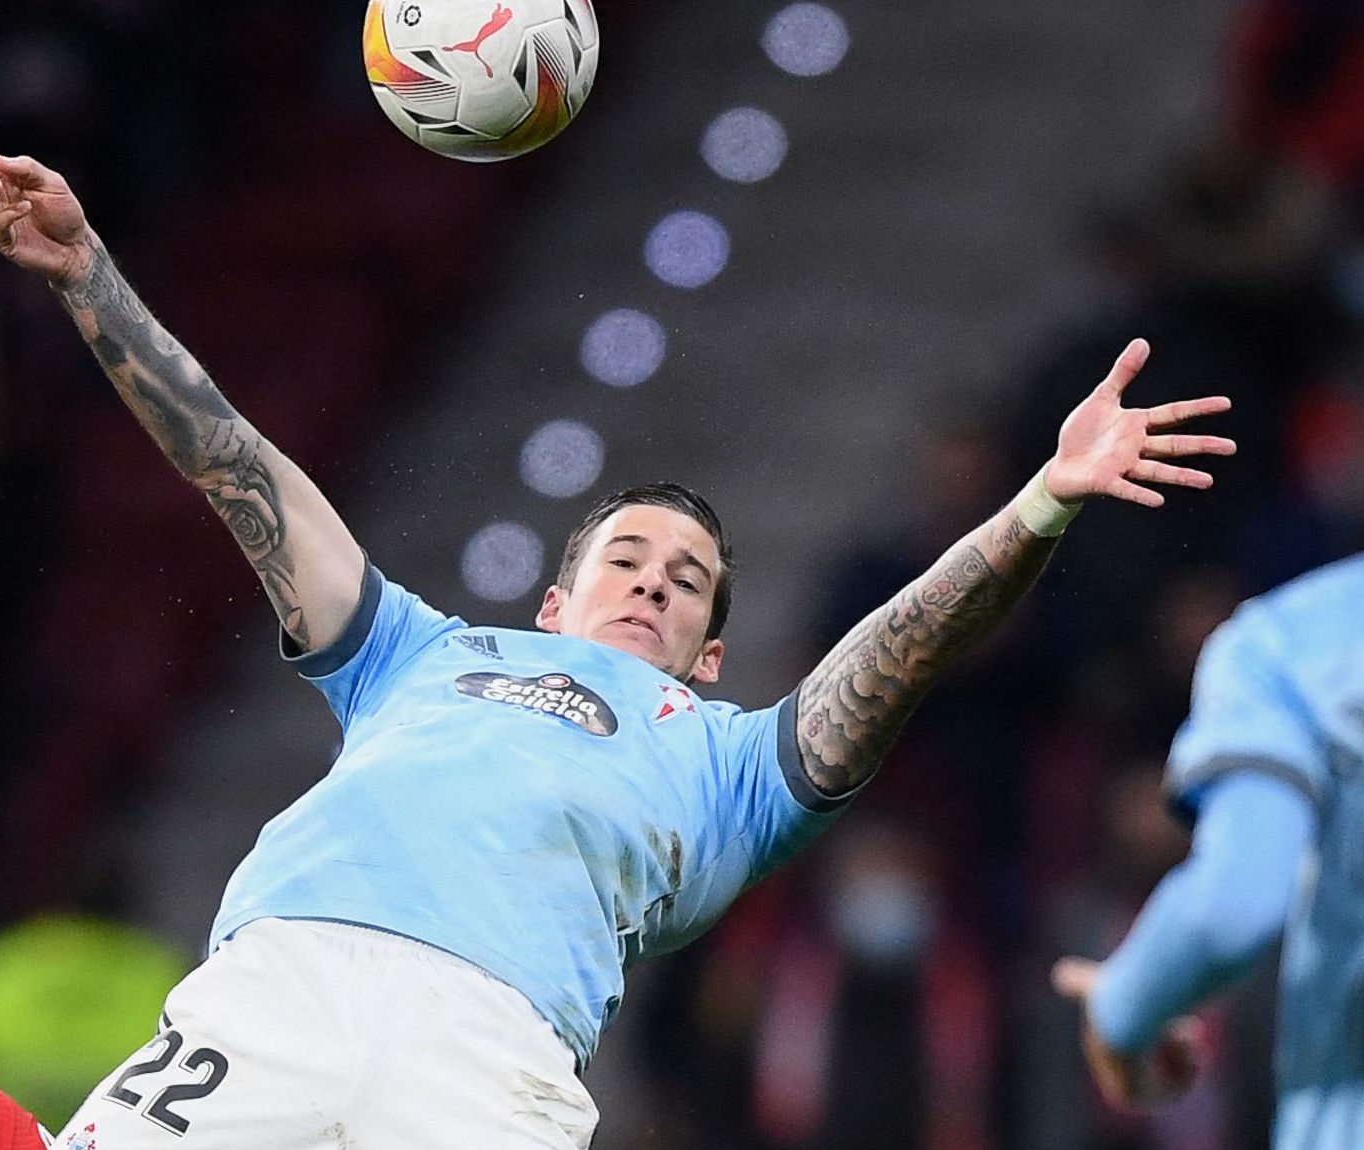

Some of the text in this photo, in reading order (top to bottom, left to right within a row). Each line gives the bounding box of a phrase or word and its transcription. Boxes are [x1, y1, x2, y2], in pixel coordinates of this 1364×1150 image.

[481, 689, 586, 724] Galicia
[486, 678, 598, 716] Estrella
[103, 1029, 229, 1136] 22
